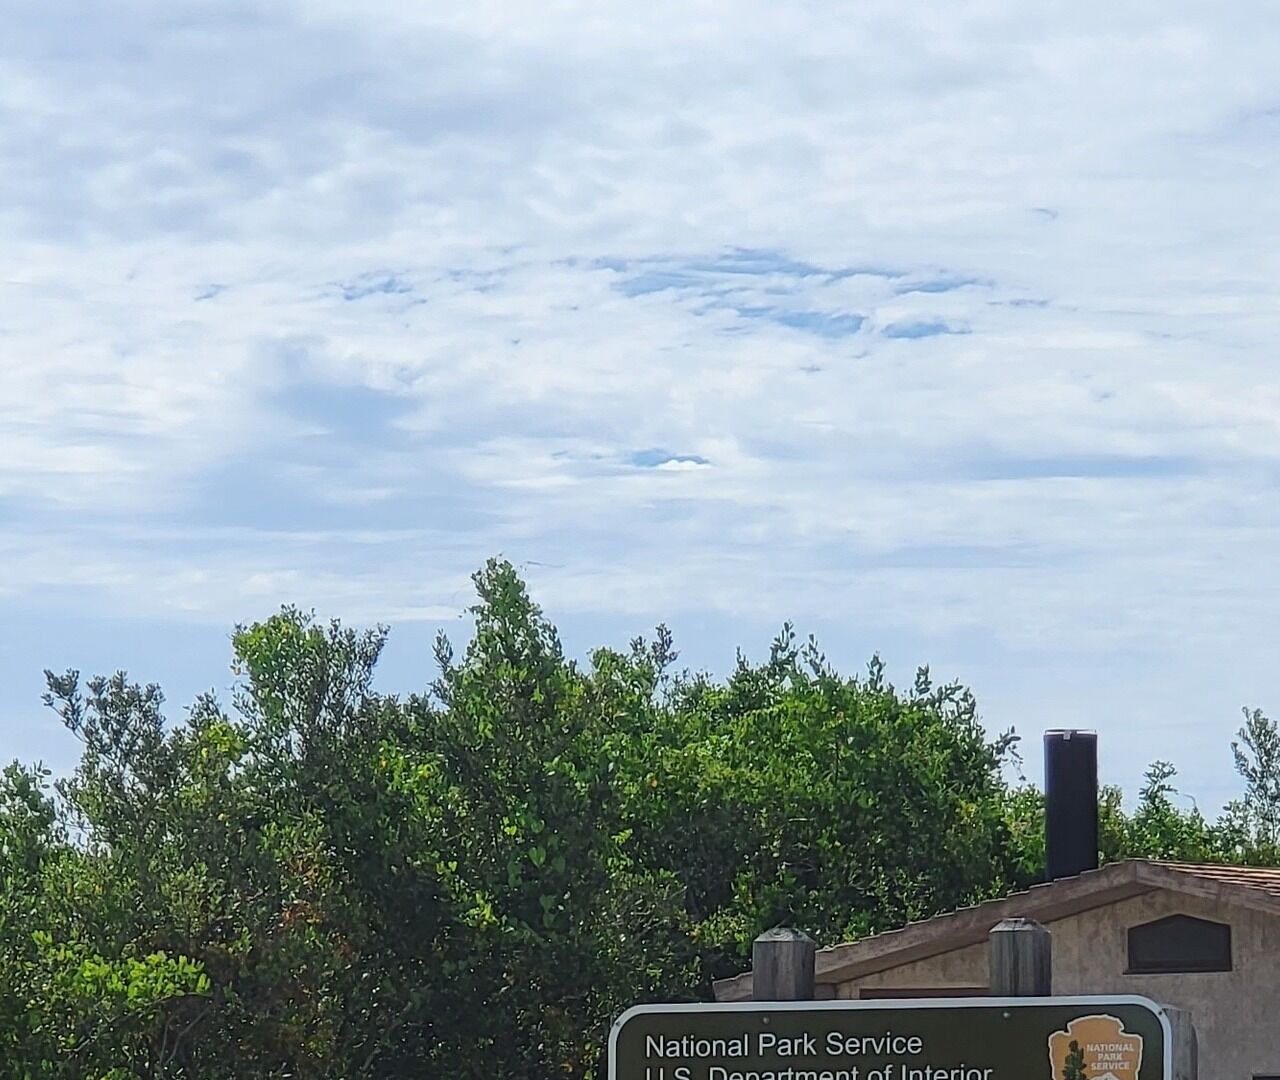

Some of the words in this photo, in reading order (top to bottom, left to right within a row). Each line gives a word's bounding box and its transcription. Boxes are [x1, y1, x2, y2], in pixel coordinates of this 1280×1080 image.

[645, 1033, 749, 1058] National
[758, 1032, 817, 1056] Park
[826, 1031, 923, 1055] Service
[1086, 1043, 1135, 1052] NATIONAL
[1097, 1053, 1123, 1061] PARK
[1091, 1061, 1130, 1071] SERVICE
